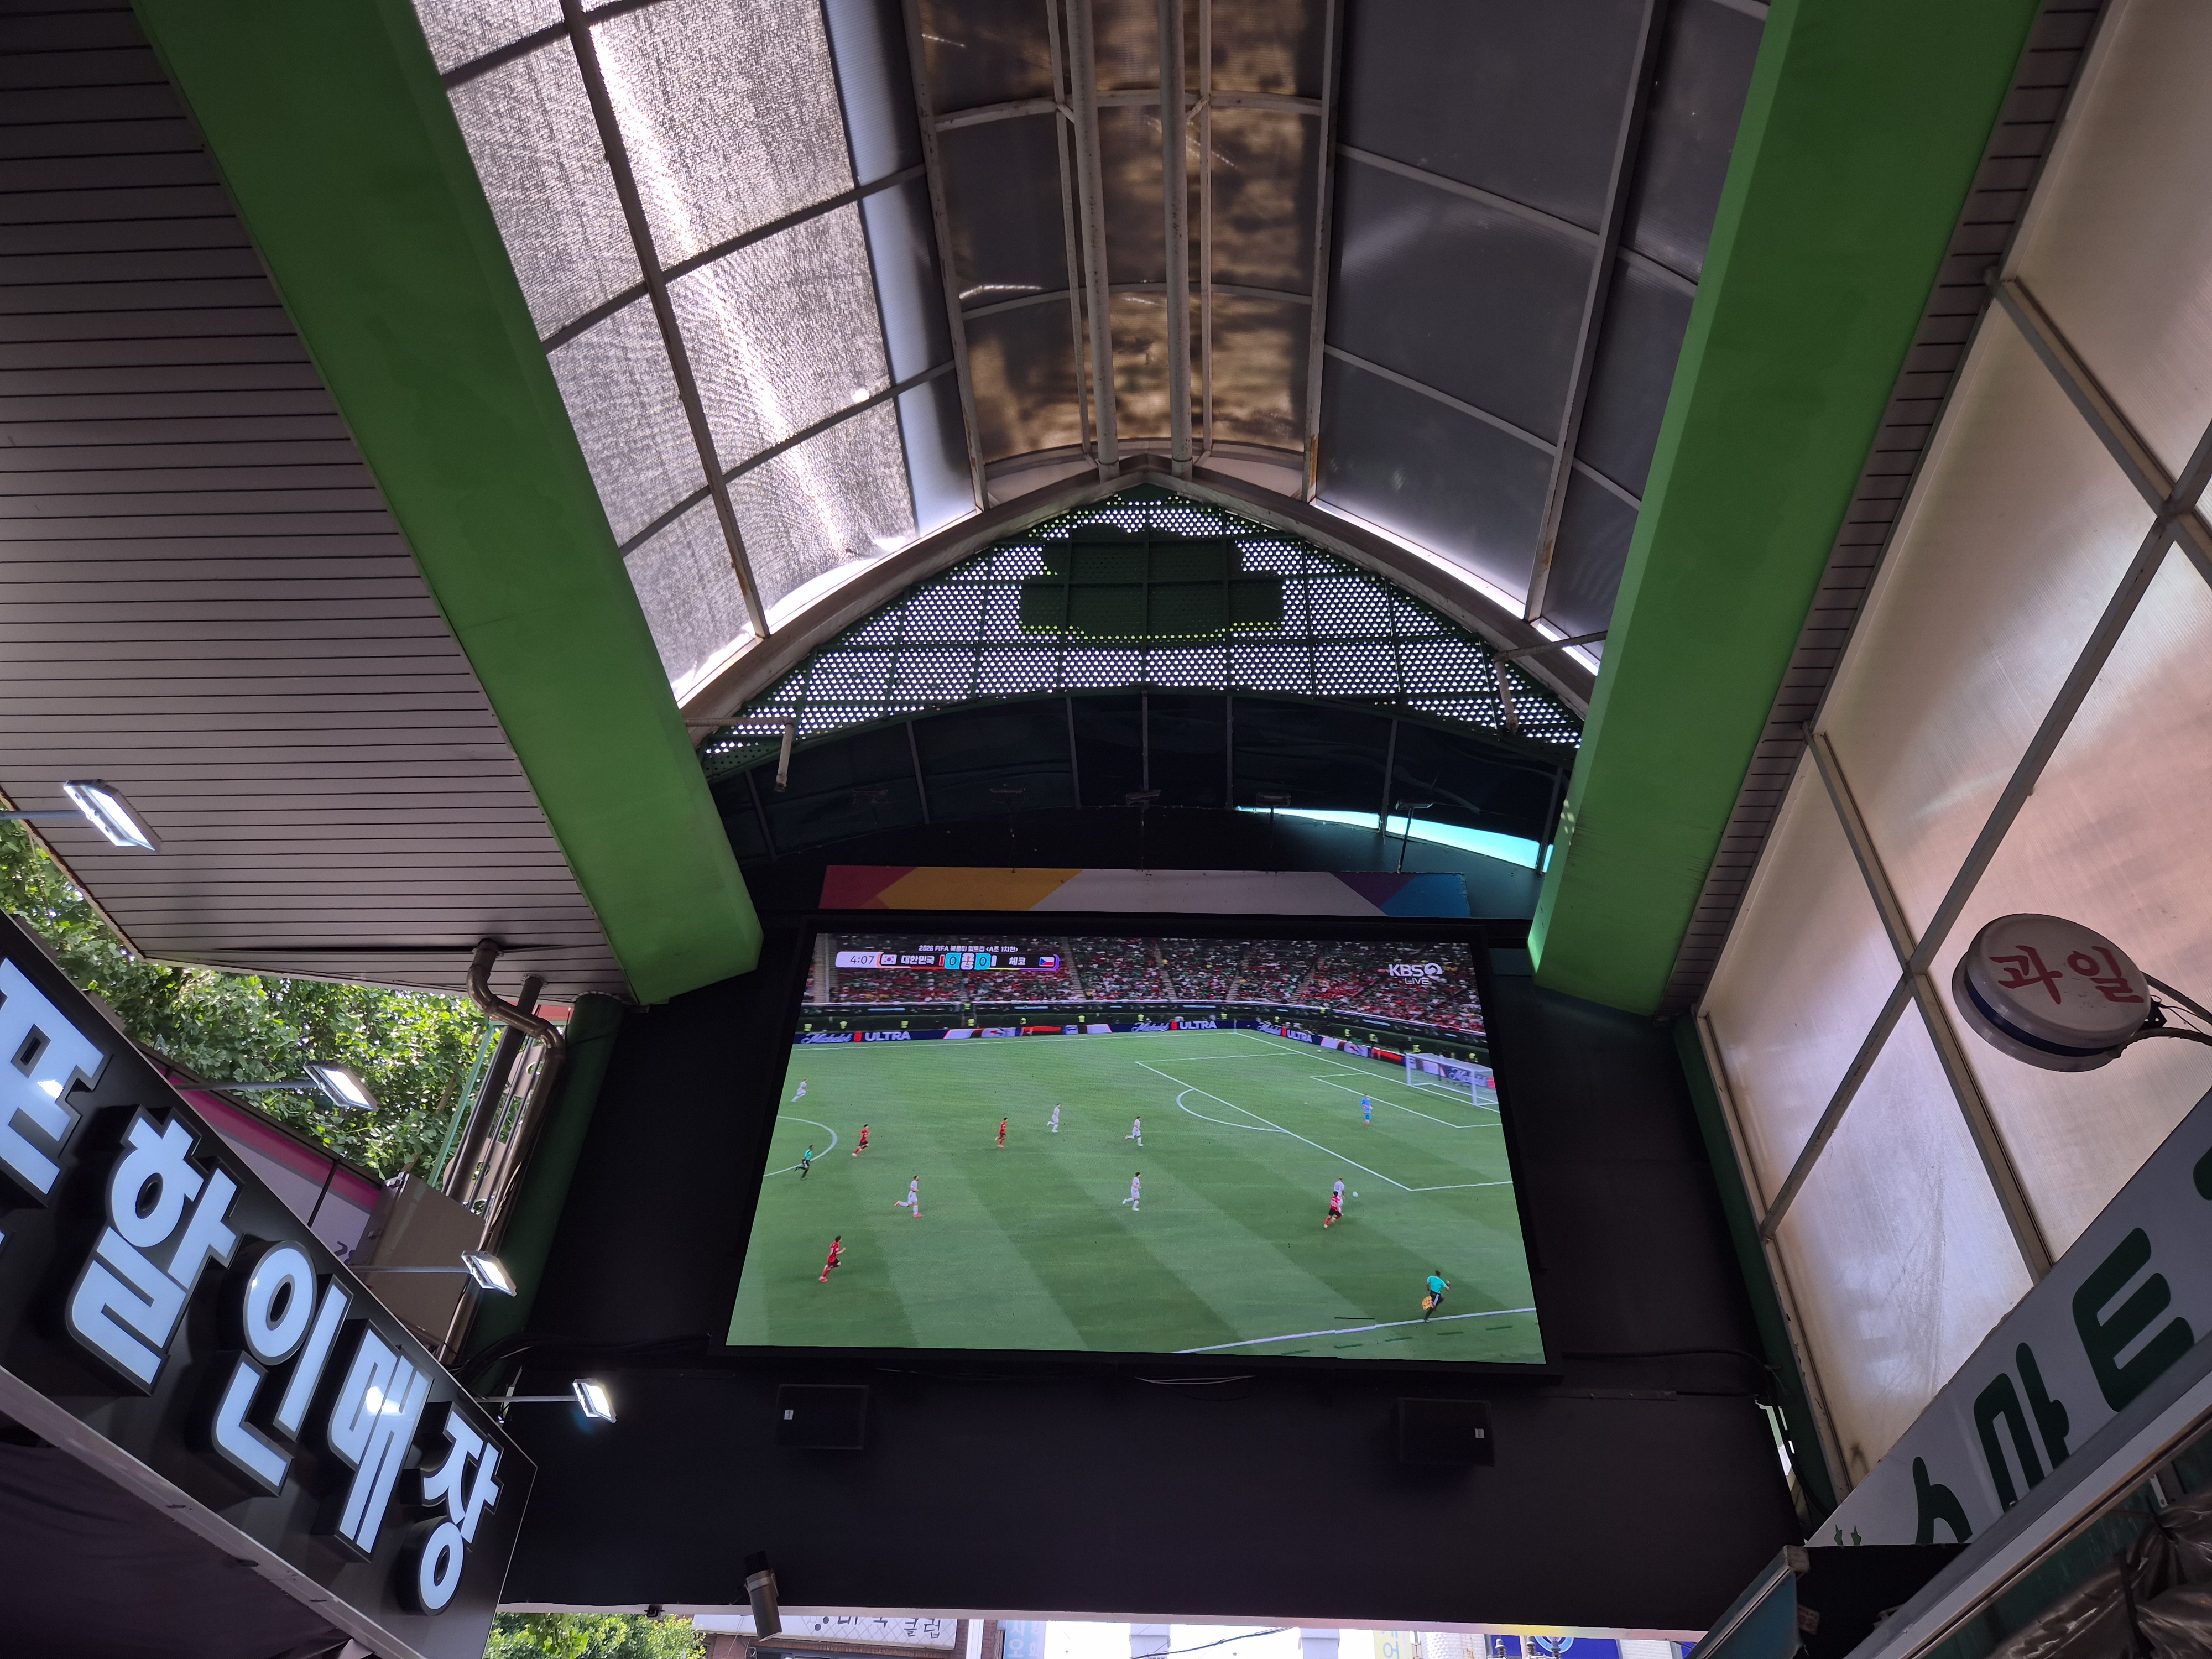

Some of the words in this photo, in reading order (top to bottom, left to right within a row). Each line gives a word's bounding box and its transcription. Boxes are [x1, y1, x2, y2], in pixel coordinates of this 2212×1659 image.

[850, 955, 875, 964] 4:07
[901, 955, 935, 964] 대한민국
[949, 956, 957, 966] 0
[979, 957, 987, 966] 0
[1009, 957, 1026, 966] 체코
[1989, 945, 2144, 1005] 과일
[1179, 1021, 1217, 1030] ULTRA
[865, 1031, 911, 1041] ULTRA
[1287, 1029, 1312, 1043] ULTRA
